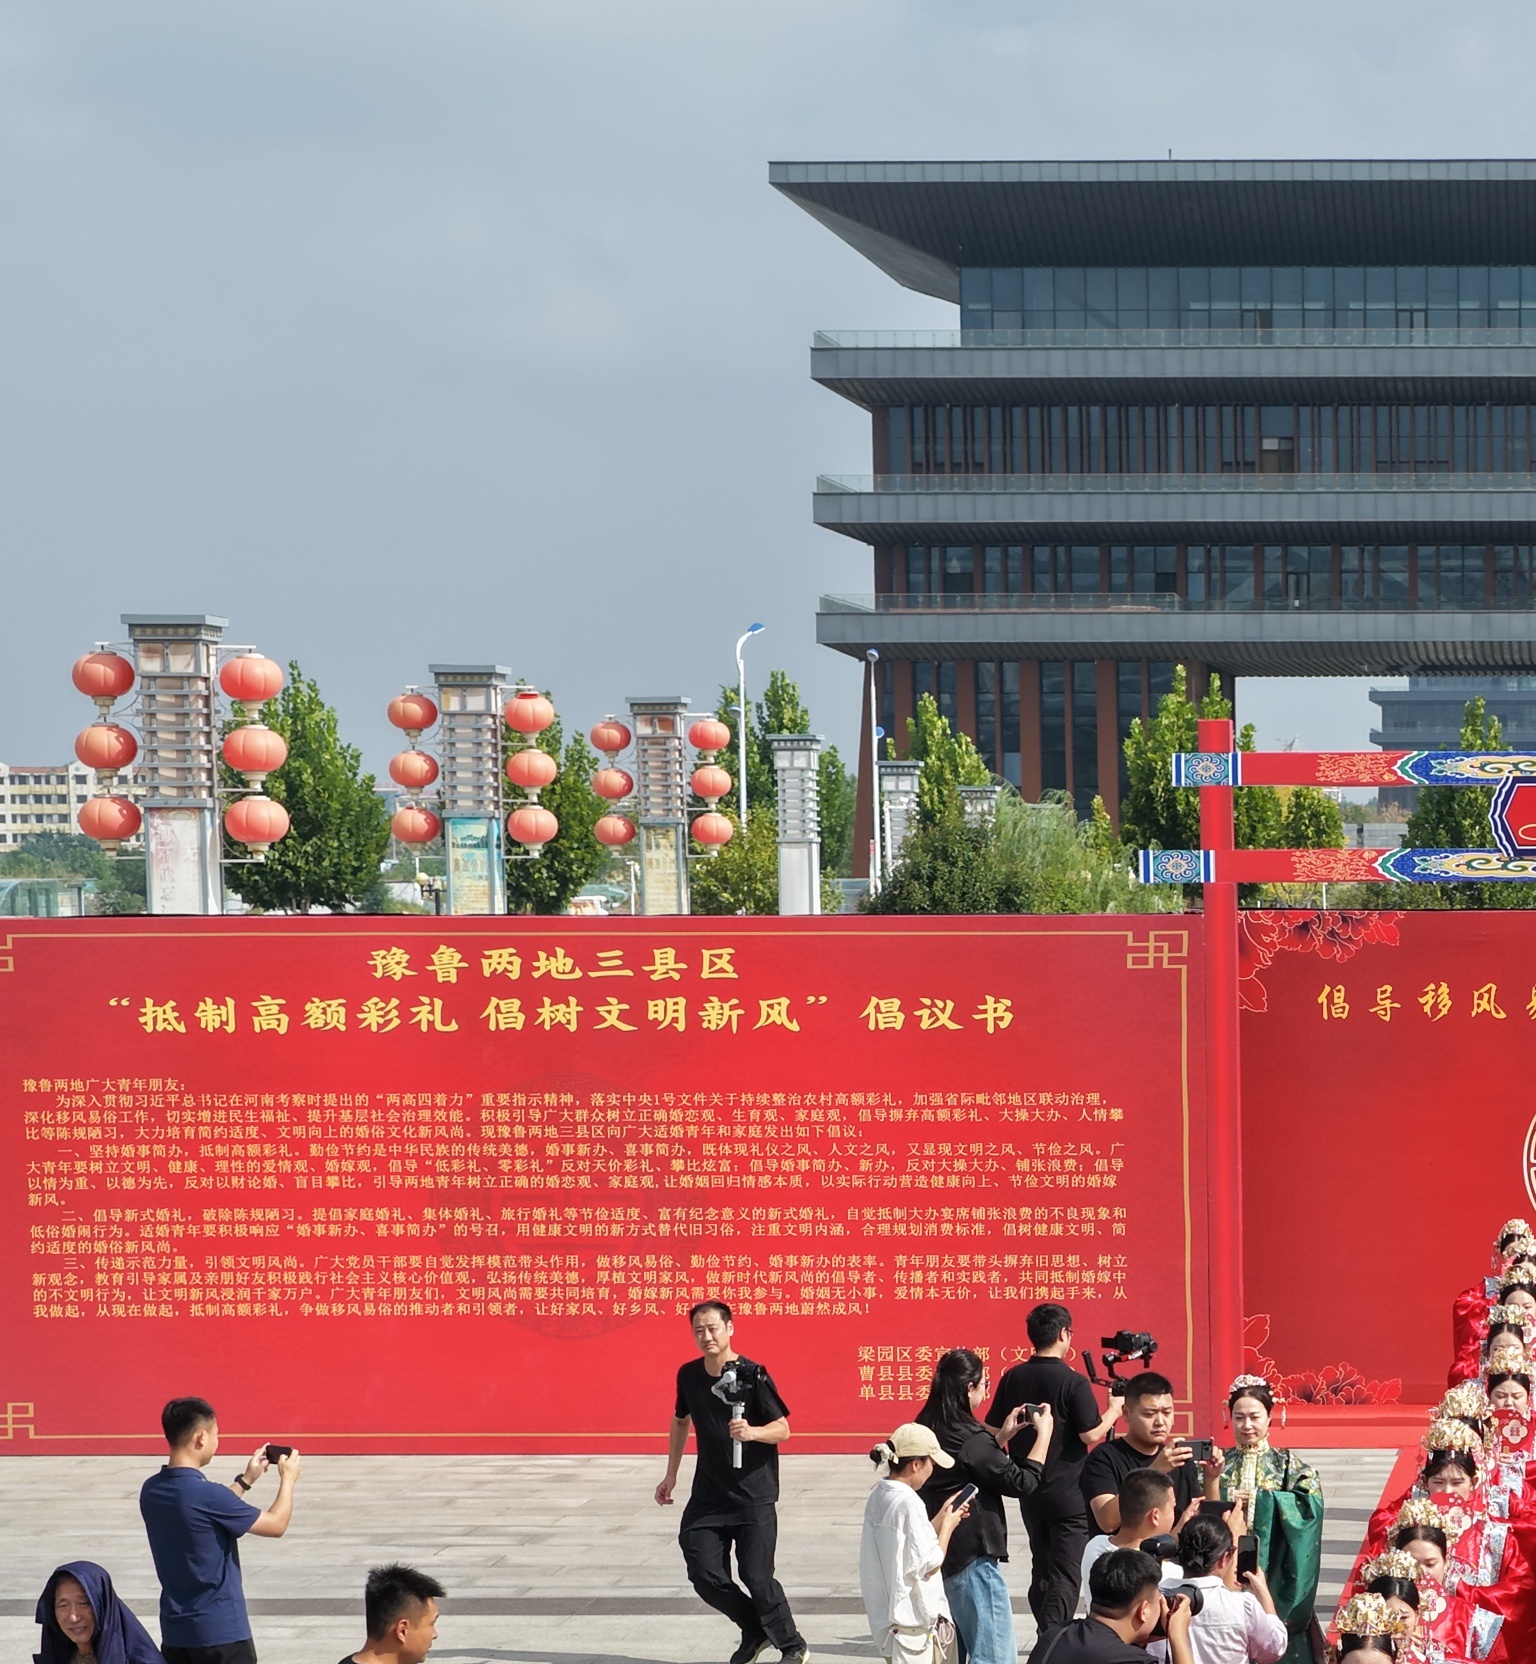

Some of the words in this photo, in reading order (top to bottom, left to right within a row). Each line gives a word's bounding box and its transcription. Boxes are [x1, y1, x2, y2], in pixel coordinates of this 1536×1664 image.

[369, 945, 741, 984] 豫鲁两地三县区
[108, 994, 459, 1035] “抵制高额彩礼
[479, 995, 828, 1035] 倡树文明新风”
[858, 994, 1015, 1035] 倡议书
[22, 1077, 186, 1093] 豫鲁两地广大青年朋友：
[27, 1192, 68, 1207] 新风。
[30, 1239, 179, 1255] 约适度的婚俗新风尚。
